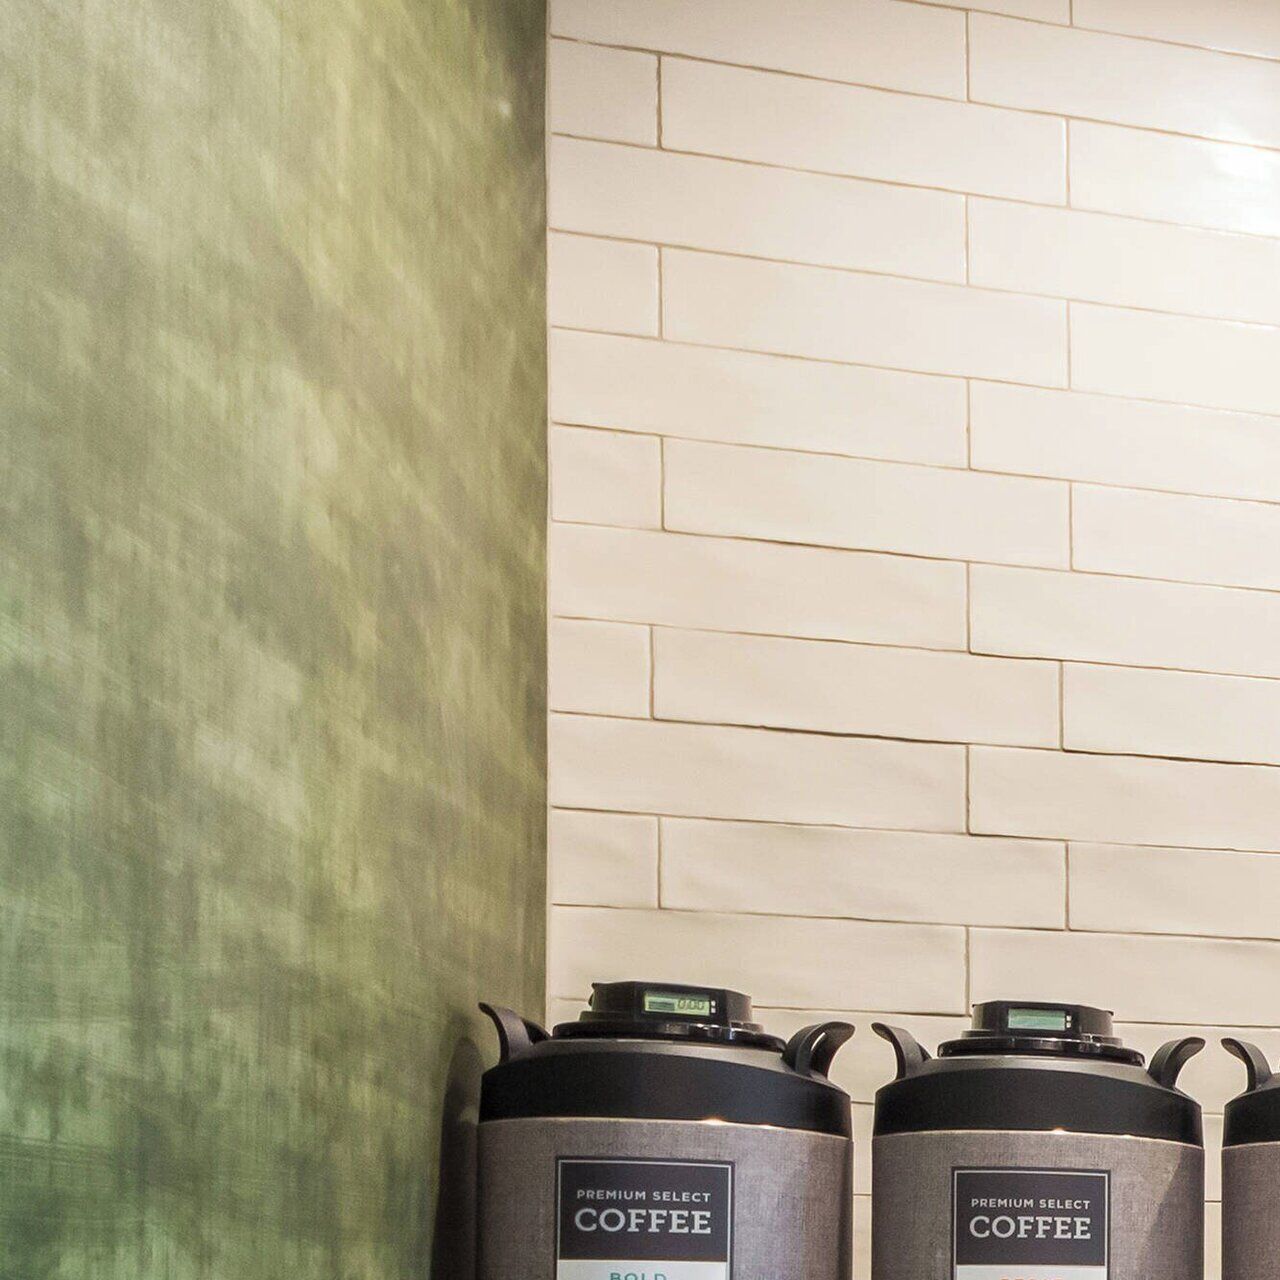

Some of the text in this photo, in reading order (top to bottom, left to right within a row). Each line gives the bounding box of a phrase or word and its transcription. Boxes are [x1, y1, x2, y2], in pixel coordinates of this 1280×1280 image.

[576, 1189, 711, 1203] PREMIUM SELECT
[971, 1198, 1091, 1210] PREMIUM SELECT
[574, 1207, 712, 1235] COFFEE
[969, 1215, 1092, 1240] COFFEE
